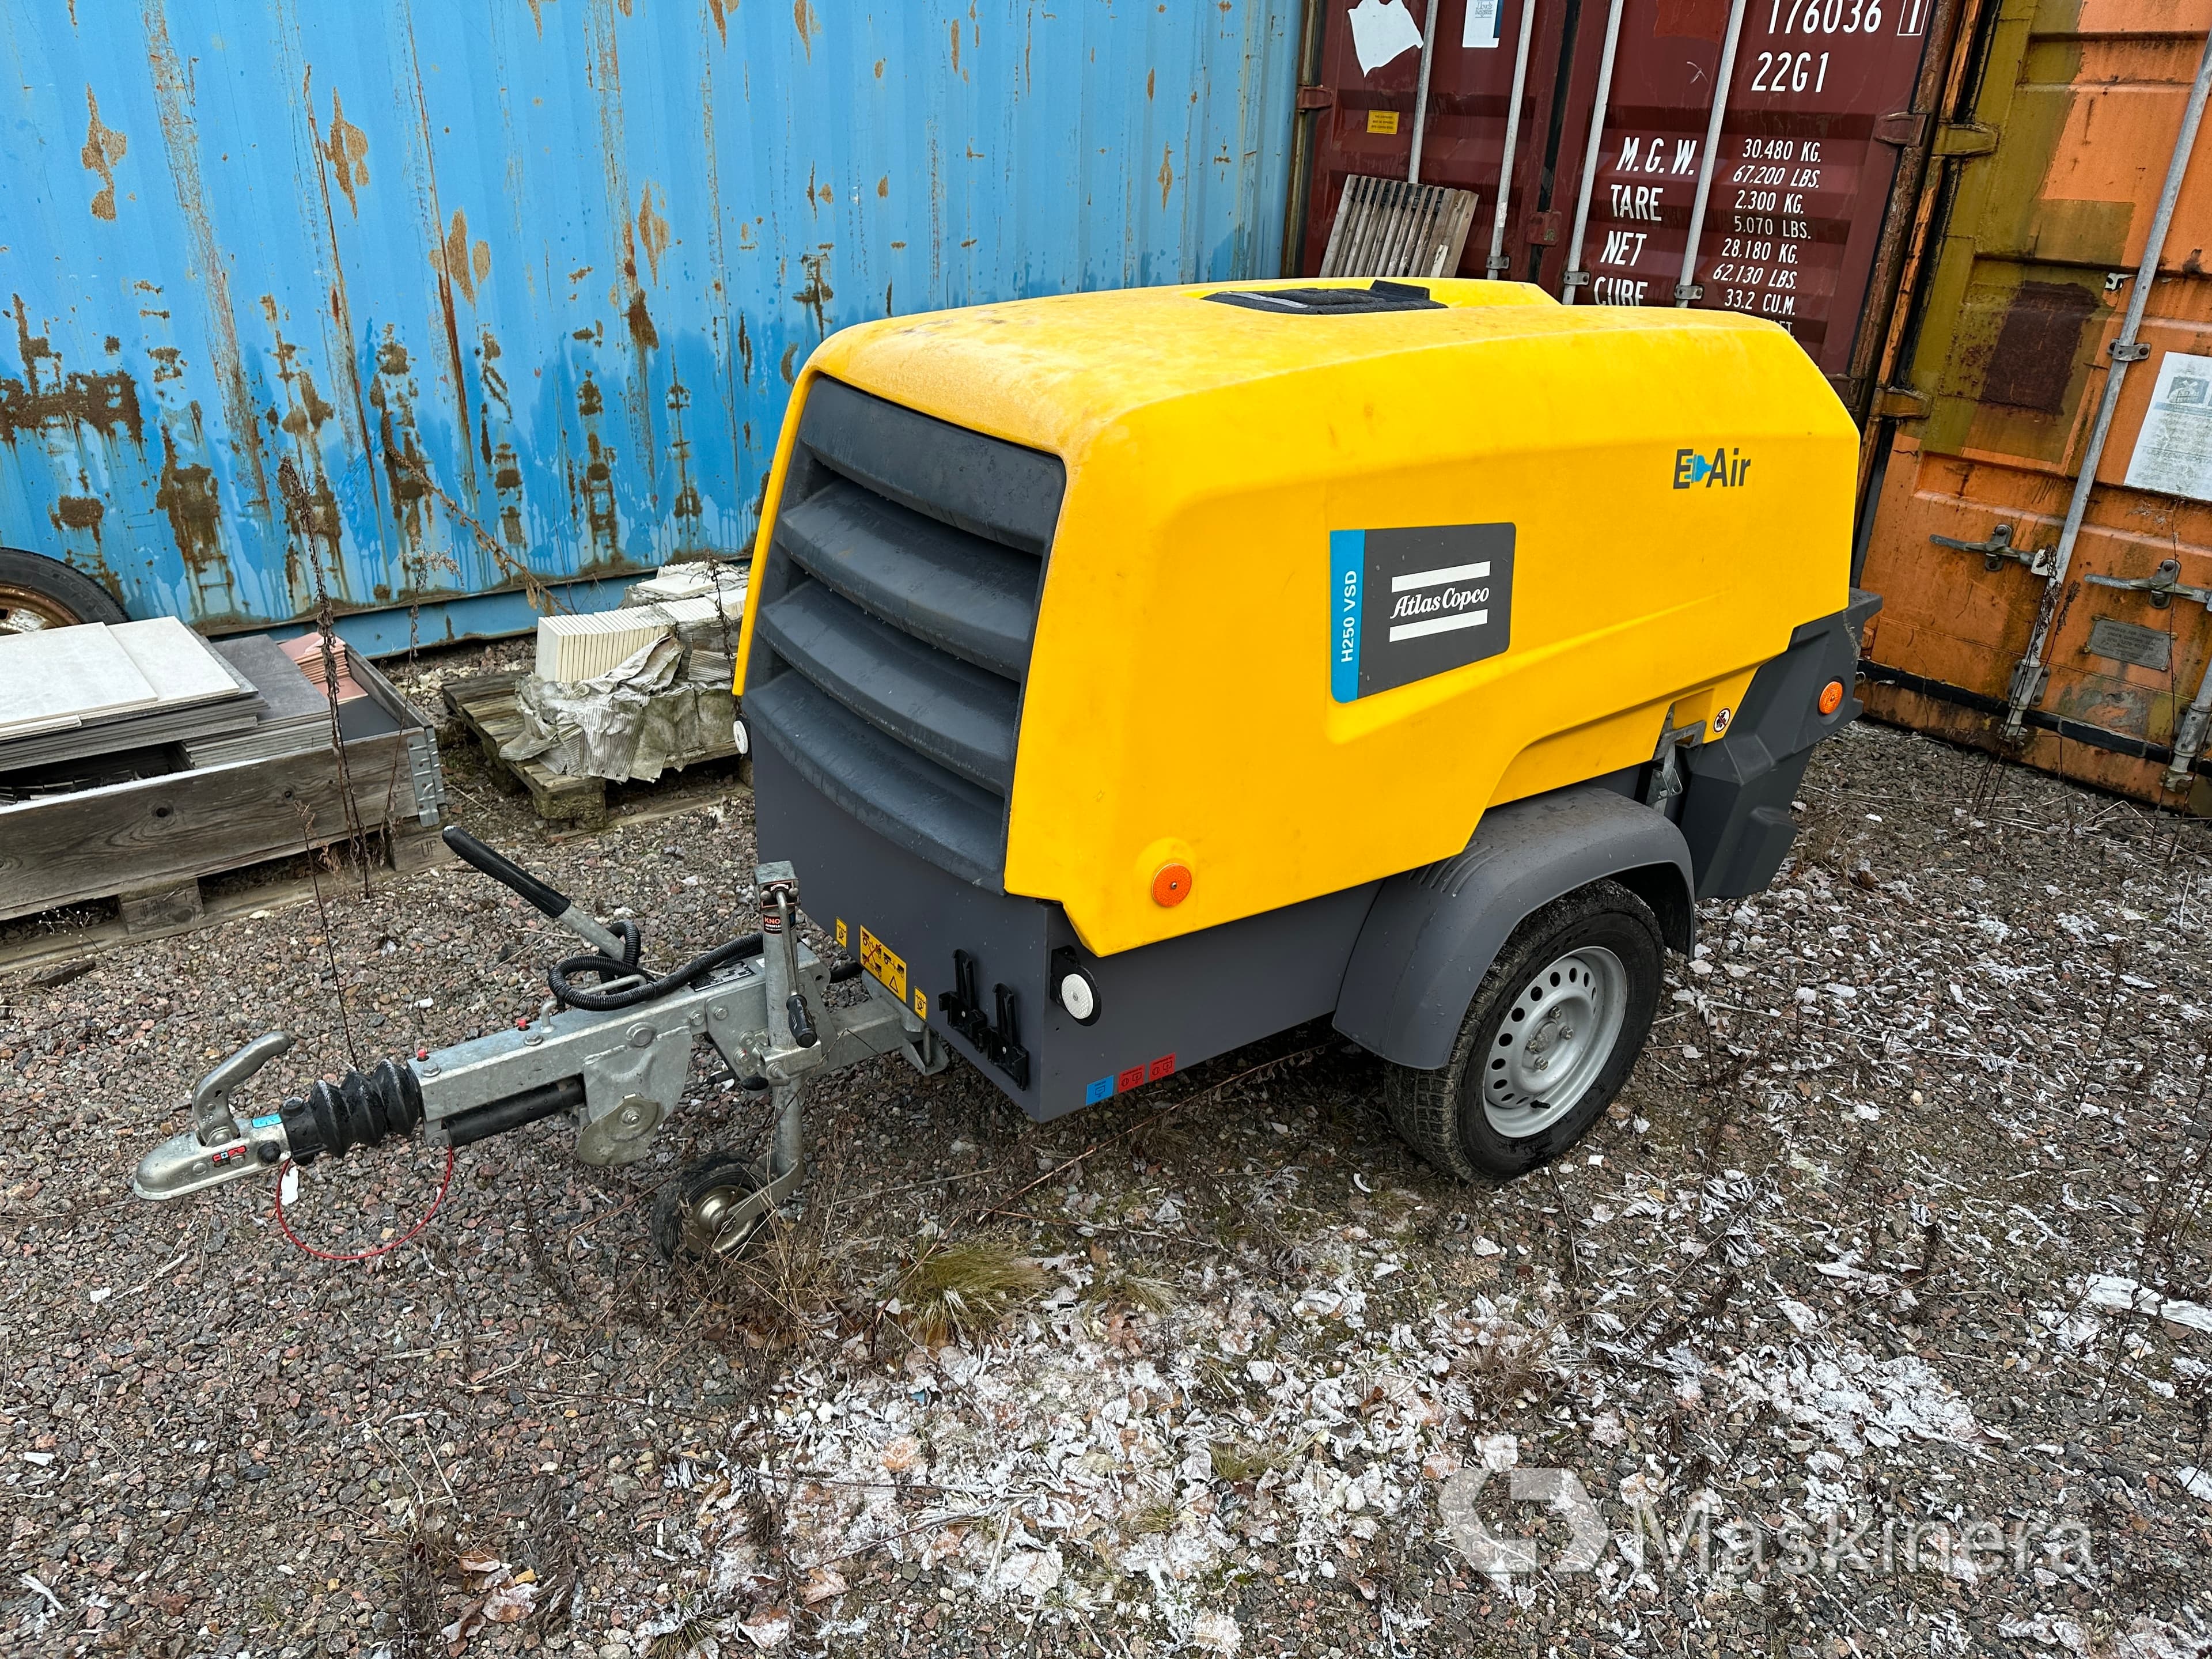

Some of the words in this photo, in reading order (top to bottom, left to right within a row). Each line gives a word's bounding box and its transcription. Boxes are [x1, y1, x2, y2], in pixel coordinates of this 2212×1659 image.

[1768, 0, 1882, 33] 176036
[1751, 52, 1829, 92] 22G1
[1800, 142, 1821, 162] KG.
[1790, 168, 1820, 188] LBS.
[1611, 184, 1664, 221] TARE
[1783, 193, 1804, 214] KG.
[1783, 219, 1812, 239] LBS.
[1600, 230, 1647, 266] NET
[1778, 243, 1798, 264] KG.
[1594, 276, 1648, 306] CUBE
[1768, 269, 1797, 290] LBS.
[1724, 289, 1755, 310] 33.2
[1344, 570, 1357, 612] VSD
[1389, 594, 1441, 619] Atlas
[1442, 587, 1490, 611] Copco
[1340, 616, 1355, 662] H250
